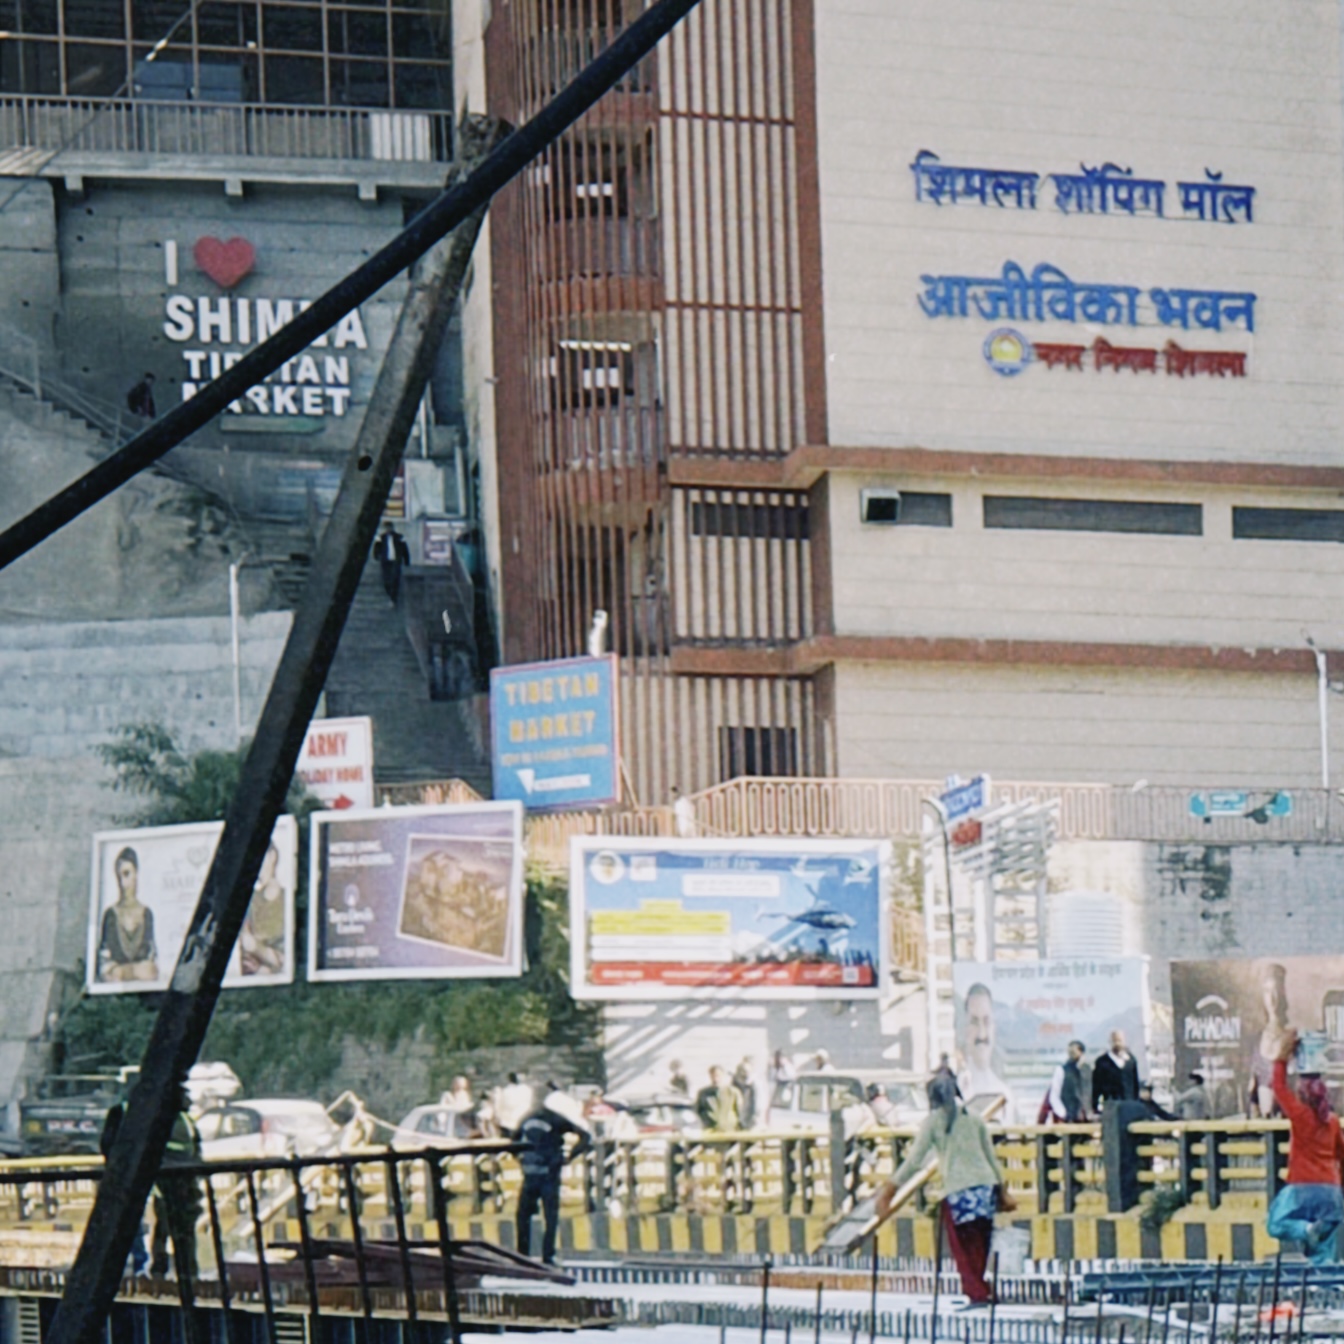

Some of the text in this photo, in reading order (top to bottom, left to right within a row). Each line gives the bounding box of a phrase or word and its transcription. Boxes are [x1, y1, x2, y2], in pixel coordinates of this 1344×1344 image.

[910, 150, 1256, 223] शिमला शॉपिंग मॉल
[165, 240, 178, 286] I
[916, 260, 1257, 333] आजीविका भवन
[505, 673, 599, 705] TIBETAN
[307, 731, 348, 758] ARMY
[509, 711, 596, 742] MARKET
